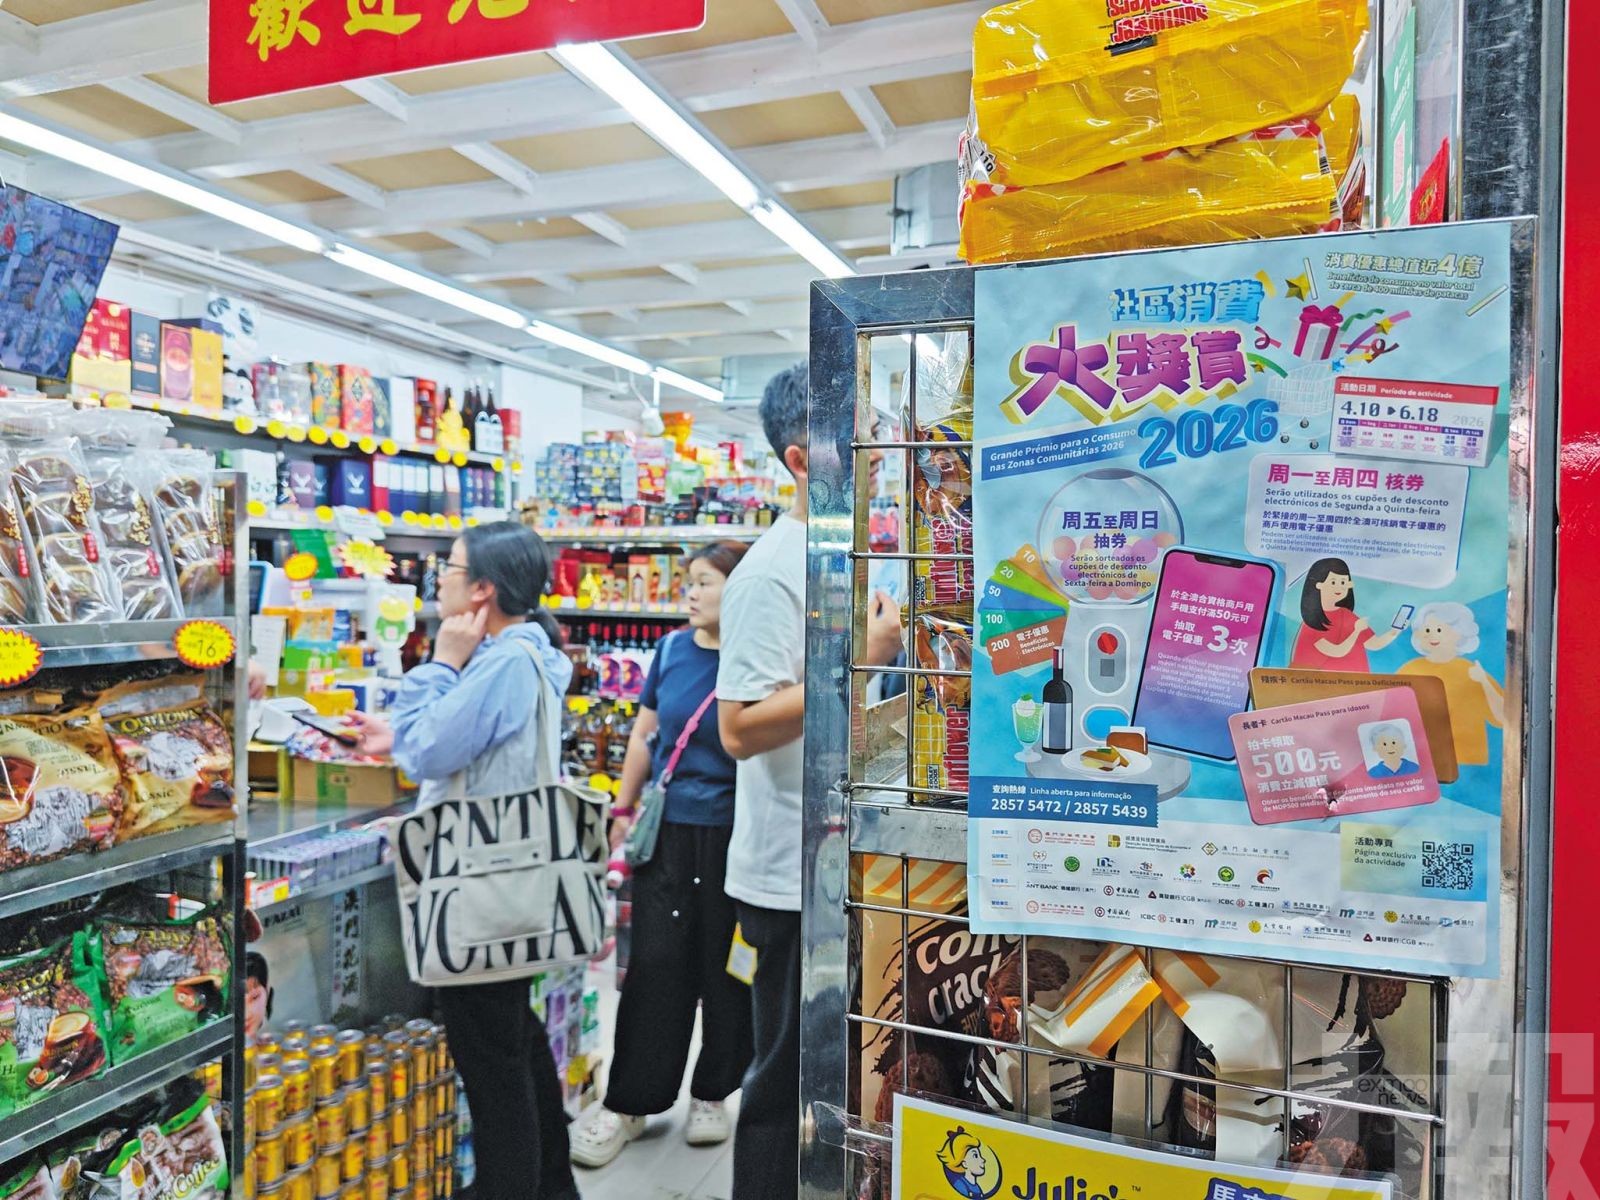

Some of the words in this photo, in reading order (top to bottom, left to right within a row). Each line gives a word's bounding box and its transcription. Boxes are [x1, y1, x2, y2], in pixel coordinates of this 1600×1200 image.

[1325, 252, 1483, 278] 消費優惠總值近4億
[1108, 280, 1266, 323] 社區消費
[1010, 324, 1250, 420] 大獎賞
[1340, 382, 1377, 393] 活動日期
[1380, 387, 1407, 395] Período
[1417, 390, 1453, 399] actividade
[1341, 400, 1380, 417] 4.10
[1400, 405, 1439, 423] 6.18
[1452, 415, 1485, 427] 2026
[1137, 398, 1280, 470] 2026
[990, 447, 1024, 461] Grande
[1025, 441, 1059, 455] Prémio
[1060, 438, 1081, 451] para
[1083, 437, 1089, 445] o
[1091, 428, 1137, 443] Consumo
[989, 463, 1006, 473] nas
[1007, 458, 1035, 469] Zonas
[1036, 446, 1100, 464] Comunitárias
[1101, 439, 1125, 452] 2026
[1267, 463, 1379, 489] 周一至周四
[1385, 473, 1425, 492] 核券
[1265, 488, 1291, 497] Serão
[1294, 490, 1338, 500] utilizados
[1354, 494, 1387, 504] cupões
[1390, 495, 1402, 504] de
[1405, 496, 1449, 507] desconto
[1264, 497, 1319, 508] electrónicos
[1321, 500, 1333, 509] de
[1334, 501, 1374, 512] Segunda
[1384, 504, 1441, 516] Quinta-feira
[1062, 510, 1159, 530] 周五至周日
[1093, 533, 1127, 549] 抽券
[1023, 550, 1036, 564] 10
[1071, 554, 1094, 562] Serão
[1095, 554, 1135, 562] sorteados
[1000, 566, 1014, 580] 20
[1069, 562, 1097, 572] cupões
[1098, 562, 1109, 570] de
[1110, 562, 1147, 570] desconto
[1077, 570, 1126, 578] electrónicos
[1127, 570, 1138, 578] de
[988, 585, 1001, 598] 50
[1065, 579, 1106, 587] Sexta-feira
[1115, 579, 1152, 588] Domingo
[985, 614, 1003, 624] 100
[1170, 602, 1250, 624] 手機支付滿50元可
[1016, 625, 1050, 642] 電子優惠
[1174, 619, 1196, 633] 抽取
[990, 638, 1010, 653] 200
[1162, 629, 1203, 646] 電子優惠
[1271, 716, 1292, 725] Cartão
[1294, 713, 1314, 722] Macau
[1331, 708, 1347, 717] para
[1347, 705, 1370, 713] Idosos
[1247, 735, 1295, 751] 拍卡領取
[1252, 747, 1342, 779] 500元
[992, 785, 1027, 795] 查詢熱線
[1257, 775, 1329, 793] 消費立減優惠
[1030, 787, 1049, 795] Linha
[1050, 788, 1073, 797] aberta
[1074, 791, 1090, 799] para
[1091, 790, 1132, 801] informação
[992, 798, 1025, 812] 2857
[1027, 800, 1062, 814] 5472
[1064, 802, 1070, 815] /
[1073, 802, 1109, 817] 2857
[1112, 804, 1148, 818] 5439
[399, 785, 604, 886] GENTLE
[1354, 836, 1393, 848] 活動專頁
[1354, 848, 1380, 857] Página
[1381, 851, 1417, 860] exclusiva
[1364, 858, 1406, 867] actividade
